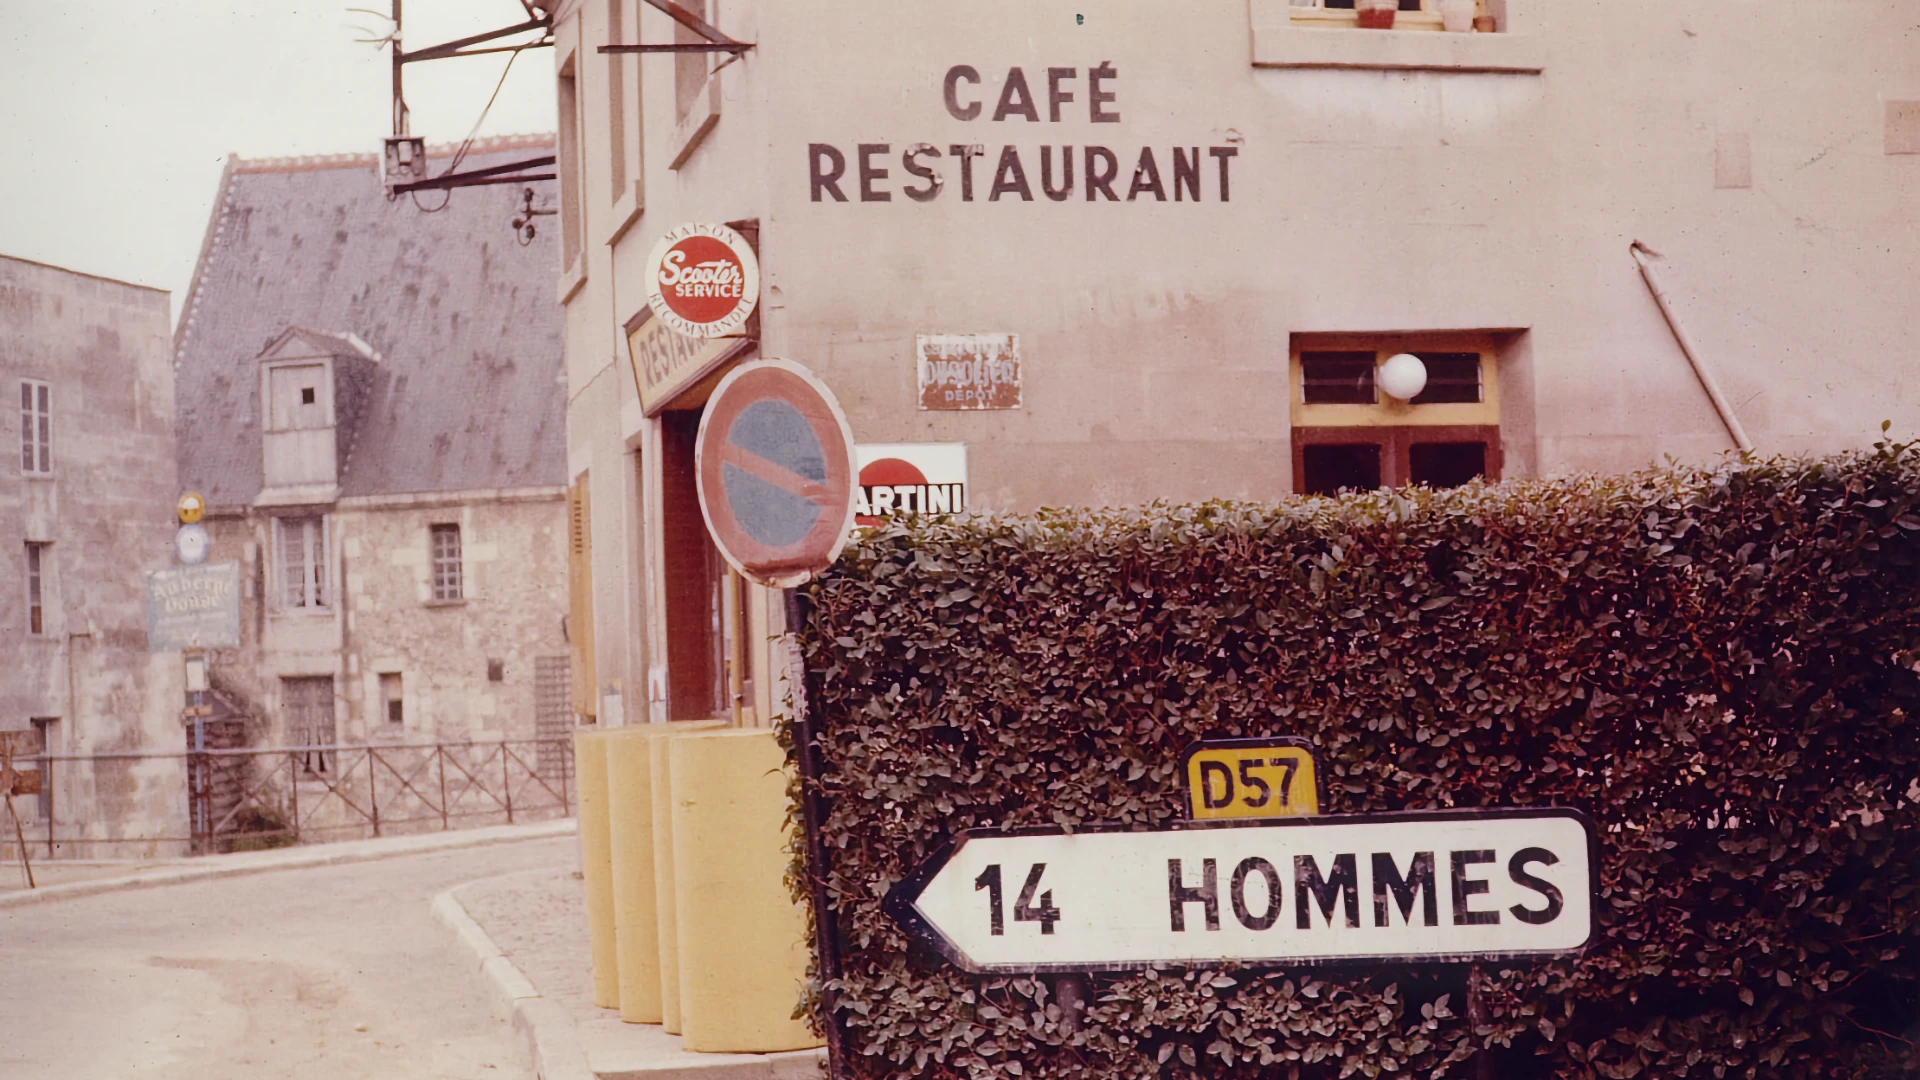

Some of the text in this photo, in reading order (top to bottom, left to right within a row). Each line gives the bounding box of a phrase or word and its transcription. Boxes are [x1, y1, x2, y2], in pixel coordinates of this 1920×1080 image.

[943, 60, 1121, 123] CAFÉ
[808, 142, 1239, 203] RESTAURANT
[663, 222, 736, 246] MAISON
[658, 250, 743, 286] Scooter
[675, 284, 742, 298] SERVICE
[856, 484, 962, 516] ARTINI
[1200, 756, 1301, 809] D57
[974, 847, 1564, 936] 14 HOMMES
